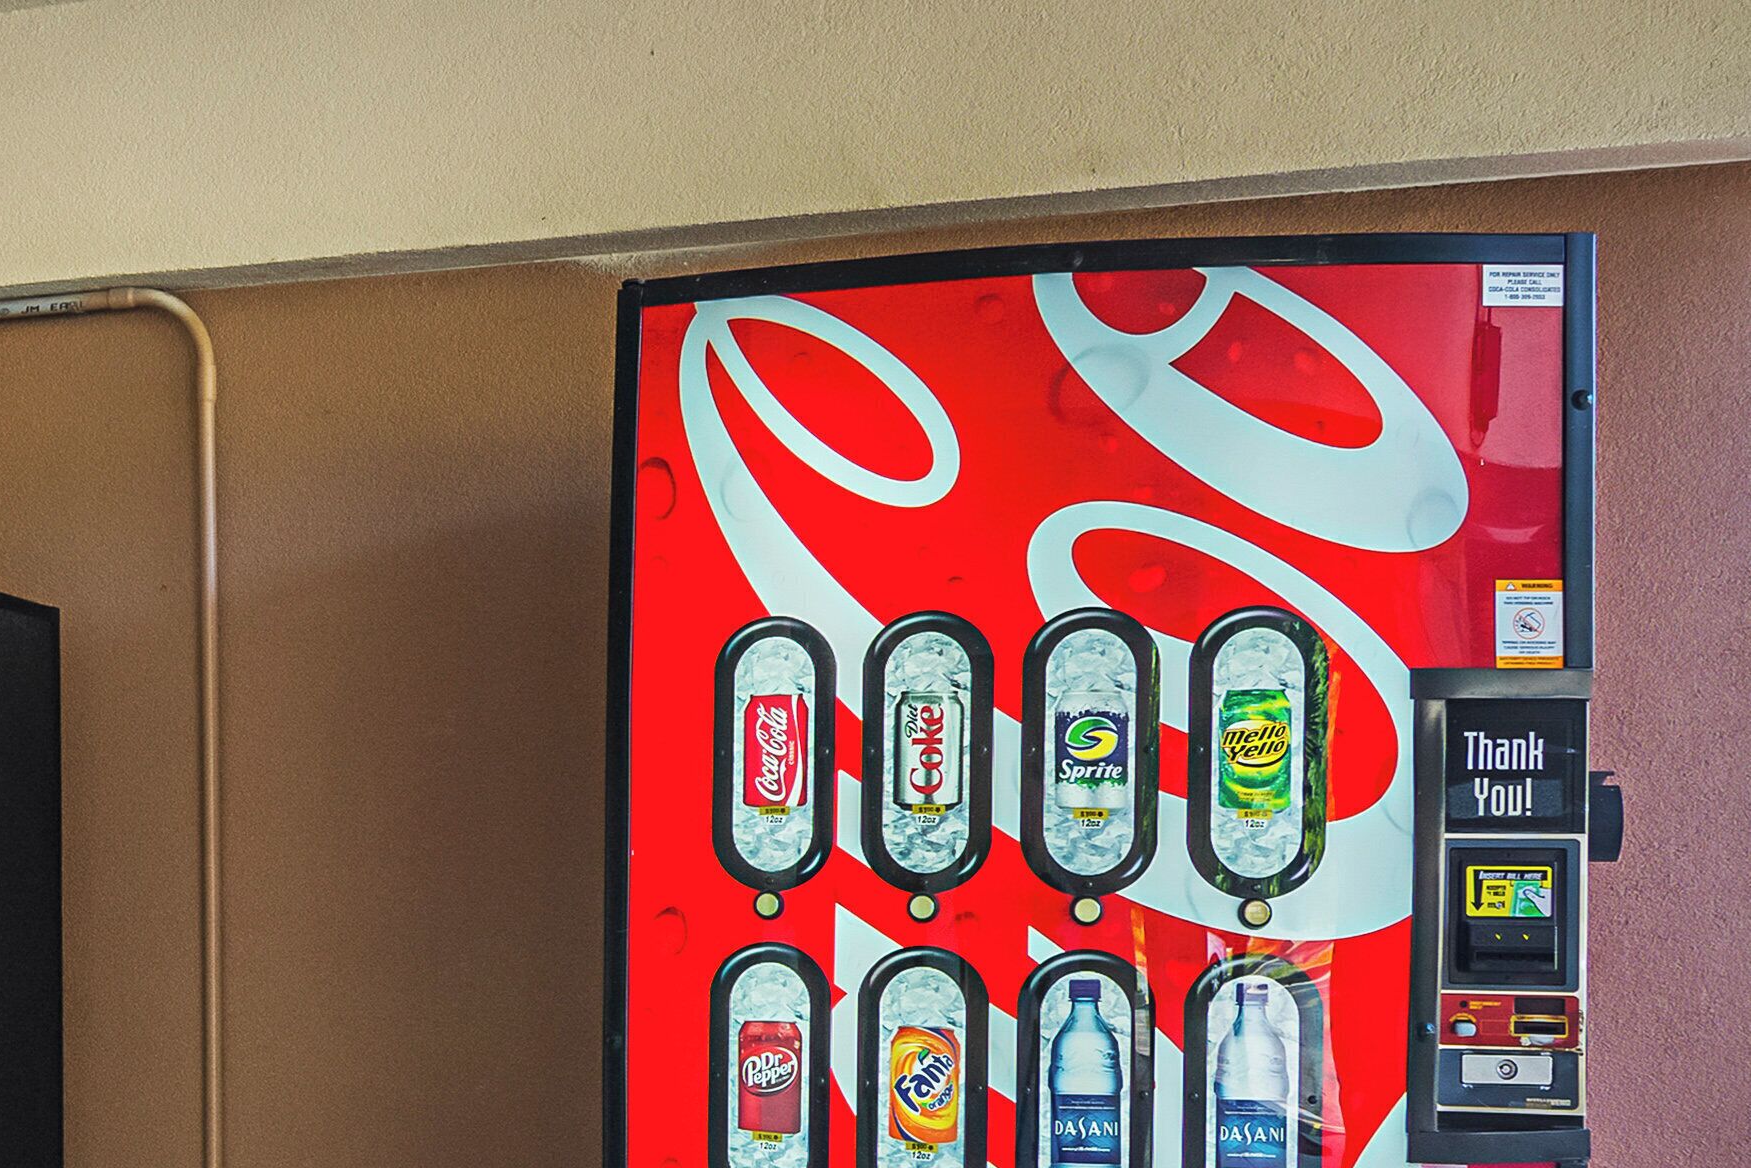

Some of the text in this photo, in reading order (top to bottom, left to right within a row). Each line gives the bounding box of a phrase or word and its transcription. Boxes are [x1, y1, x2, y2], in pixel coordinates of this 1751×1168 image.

[905, 703, 918, 739] Diet
[1223, 724, 1287, 746] Mello
[909, 704, 945, 796] Coke
[1229, 740, 1286, 762] Yello
[1463, 731, 1544, 771] Thank
[1058, 759, 1123, 783] Sprite
[1474, 778, 1532, 817] You!
[743, 1056, 795, 1088] Pepper
[761, 1051, 783, 1070] Dr
[893, 1052, 955, 1114] Fanta
[928, 1083, 954, 1110] orange
[1054, 1116, 1119, 1140] DASANI
[1219, 1122, 1285, 1146] DASANI
